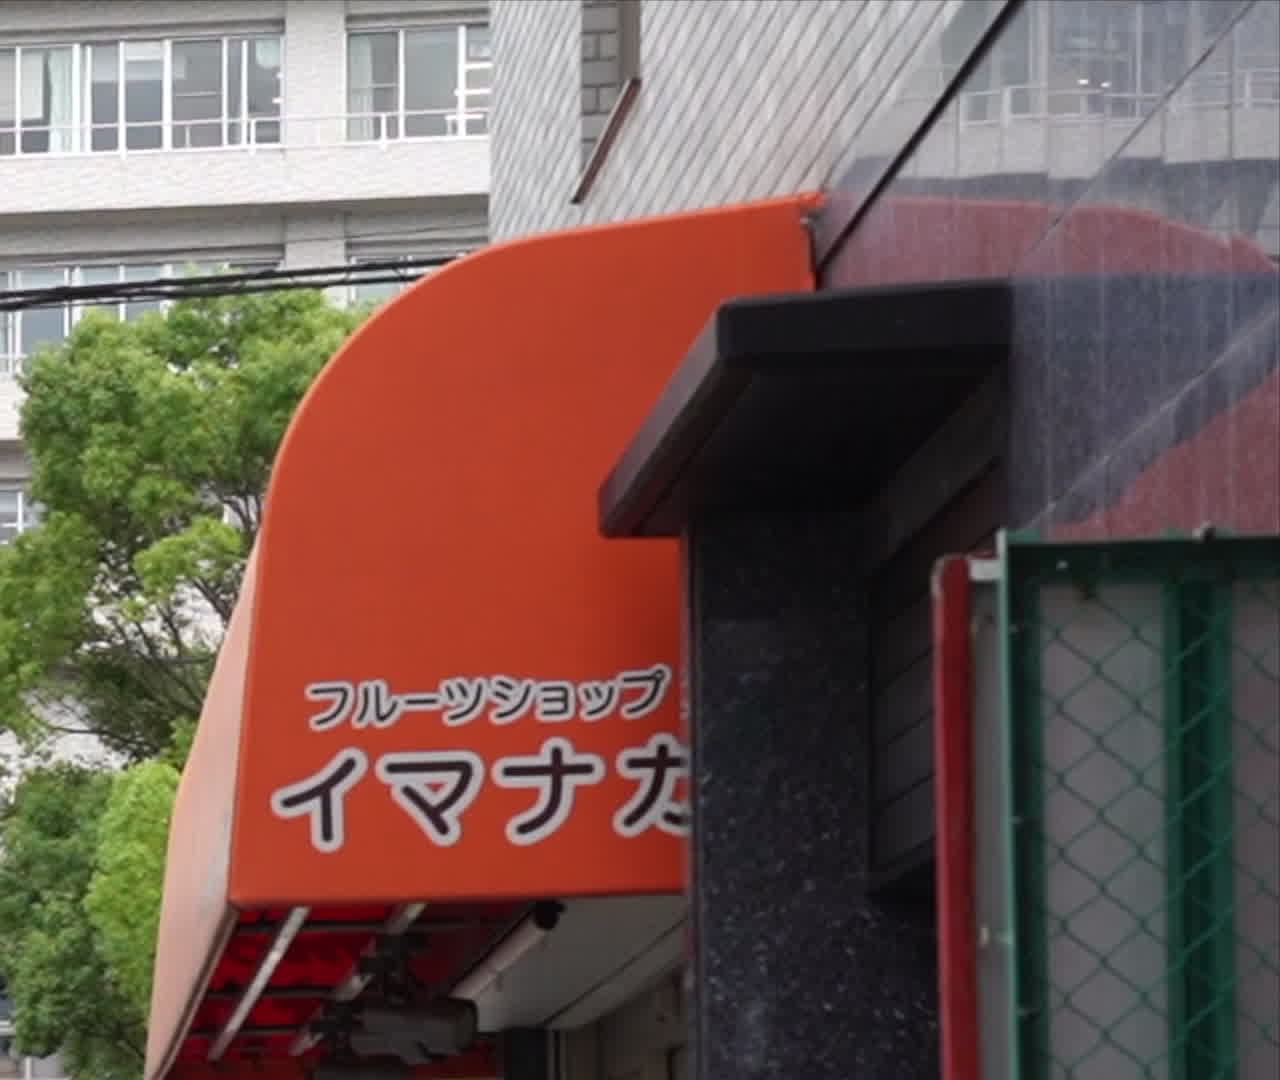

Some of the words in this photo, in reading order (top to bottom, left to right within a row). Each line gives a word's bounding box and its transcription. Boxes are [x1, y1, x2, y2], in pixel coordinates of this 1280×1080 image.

[306, 665, 670, 730] フルーツショップ
